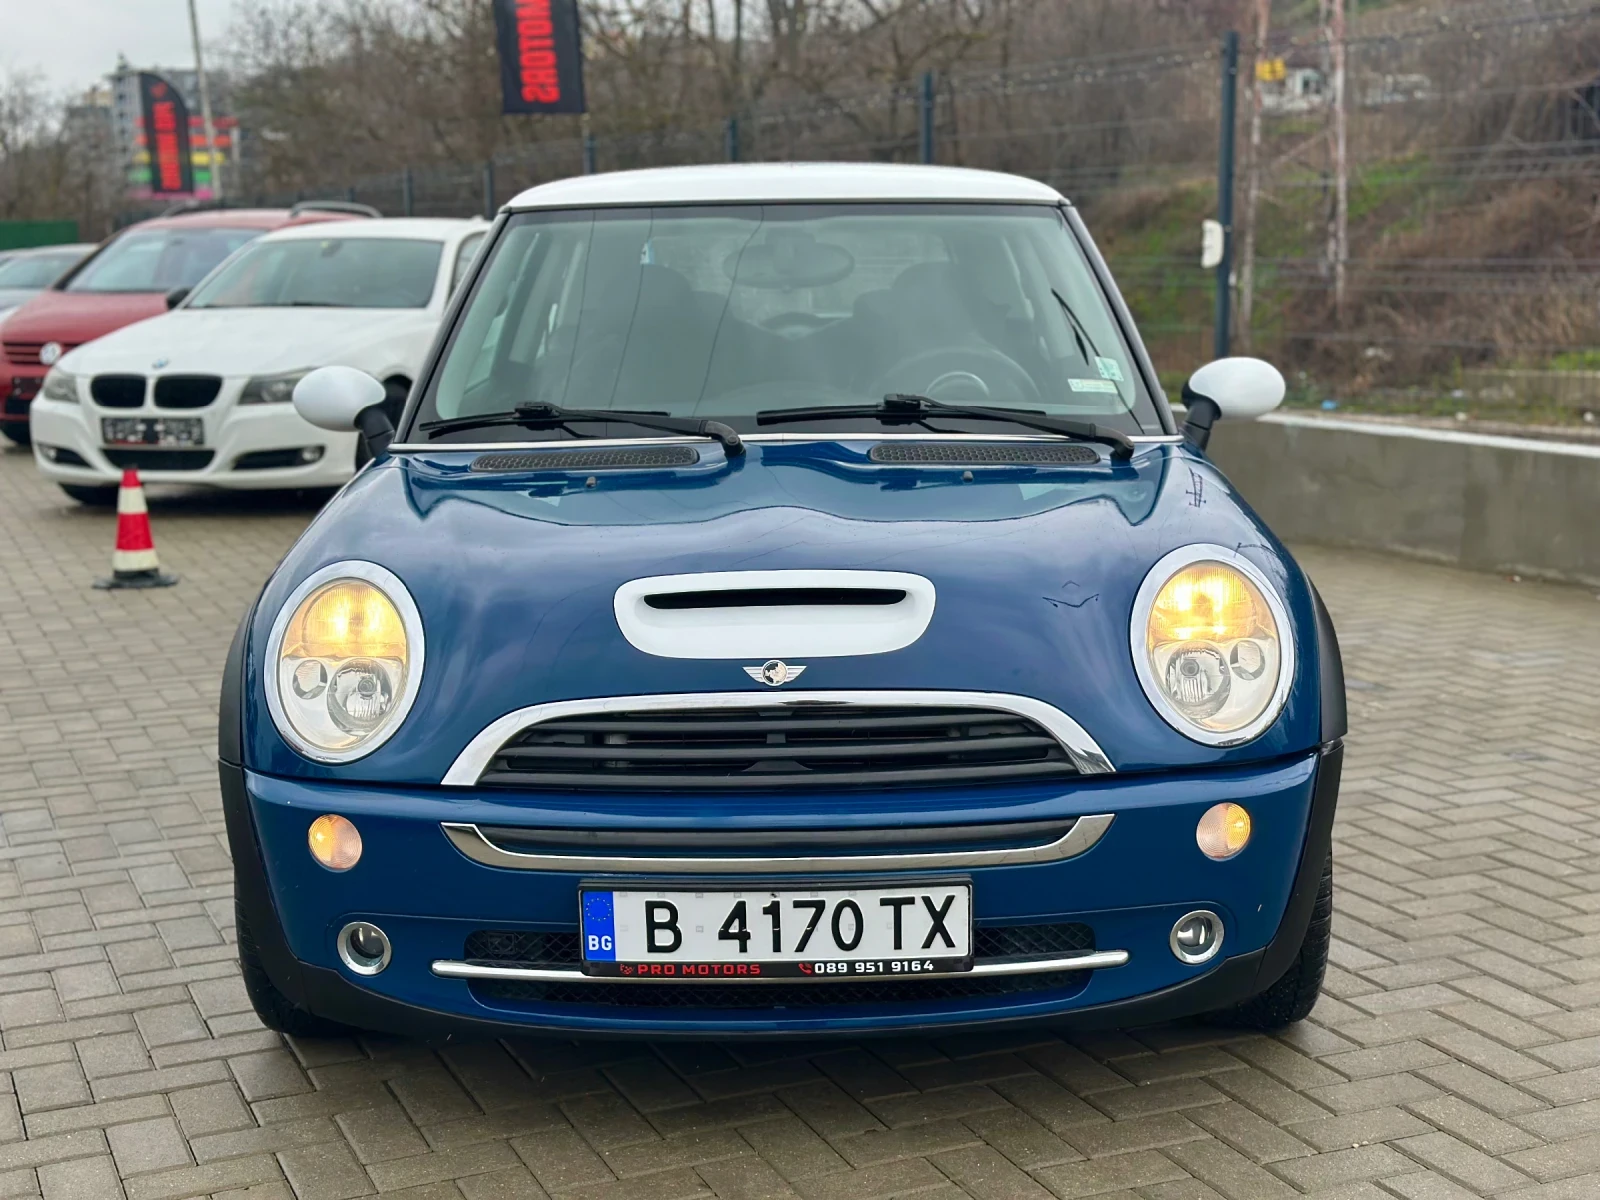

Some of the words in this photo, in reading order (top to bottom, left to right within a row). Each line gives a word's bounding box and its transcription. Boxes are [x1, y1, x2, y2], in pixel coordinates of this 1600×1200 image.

[645, 900, 683, 953] B
[718, 898, 864, 953] 4170
[880, 895, 956, 950] TX
[588, 935, 612, 951] BG
[637, 964, 675, 975] PRO
[682, 964, 761, 975] MOTORS
[814, 962, 848, 974] 089
[855, 961, 884, 973] 951
[891, 960, 934, 972] 9164
